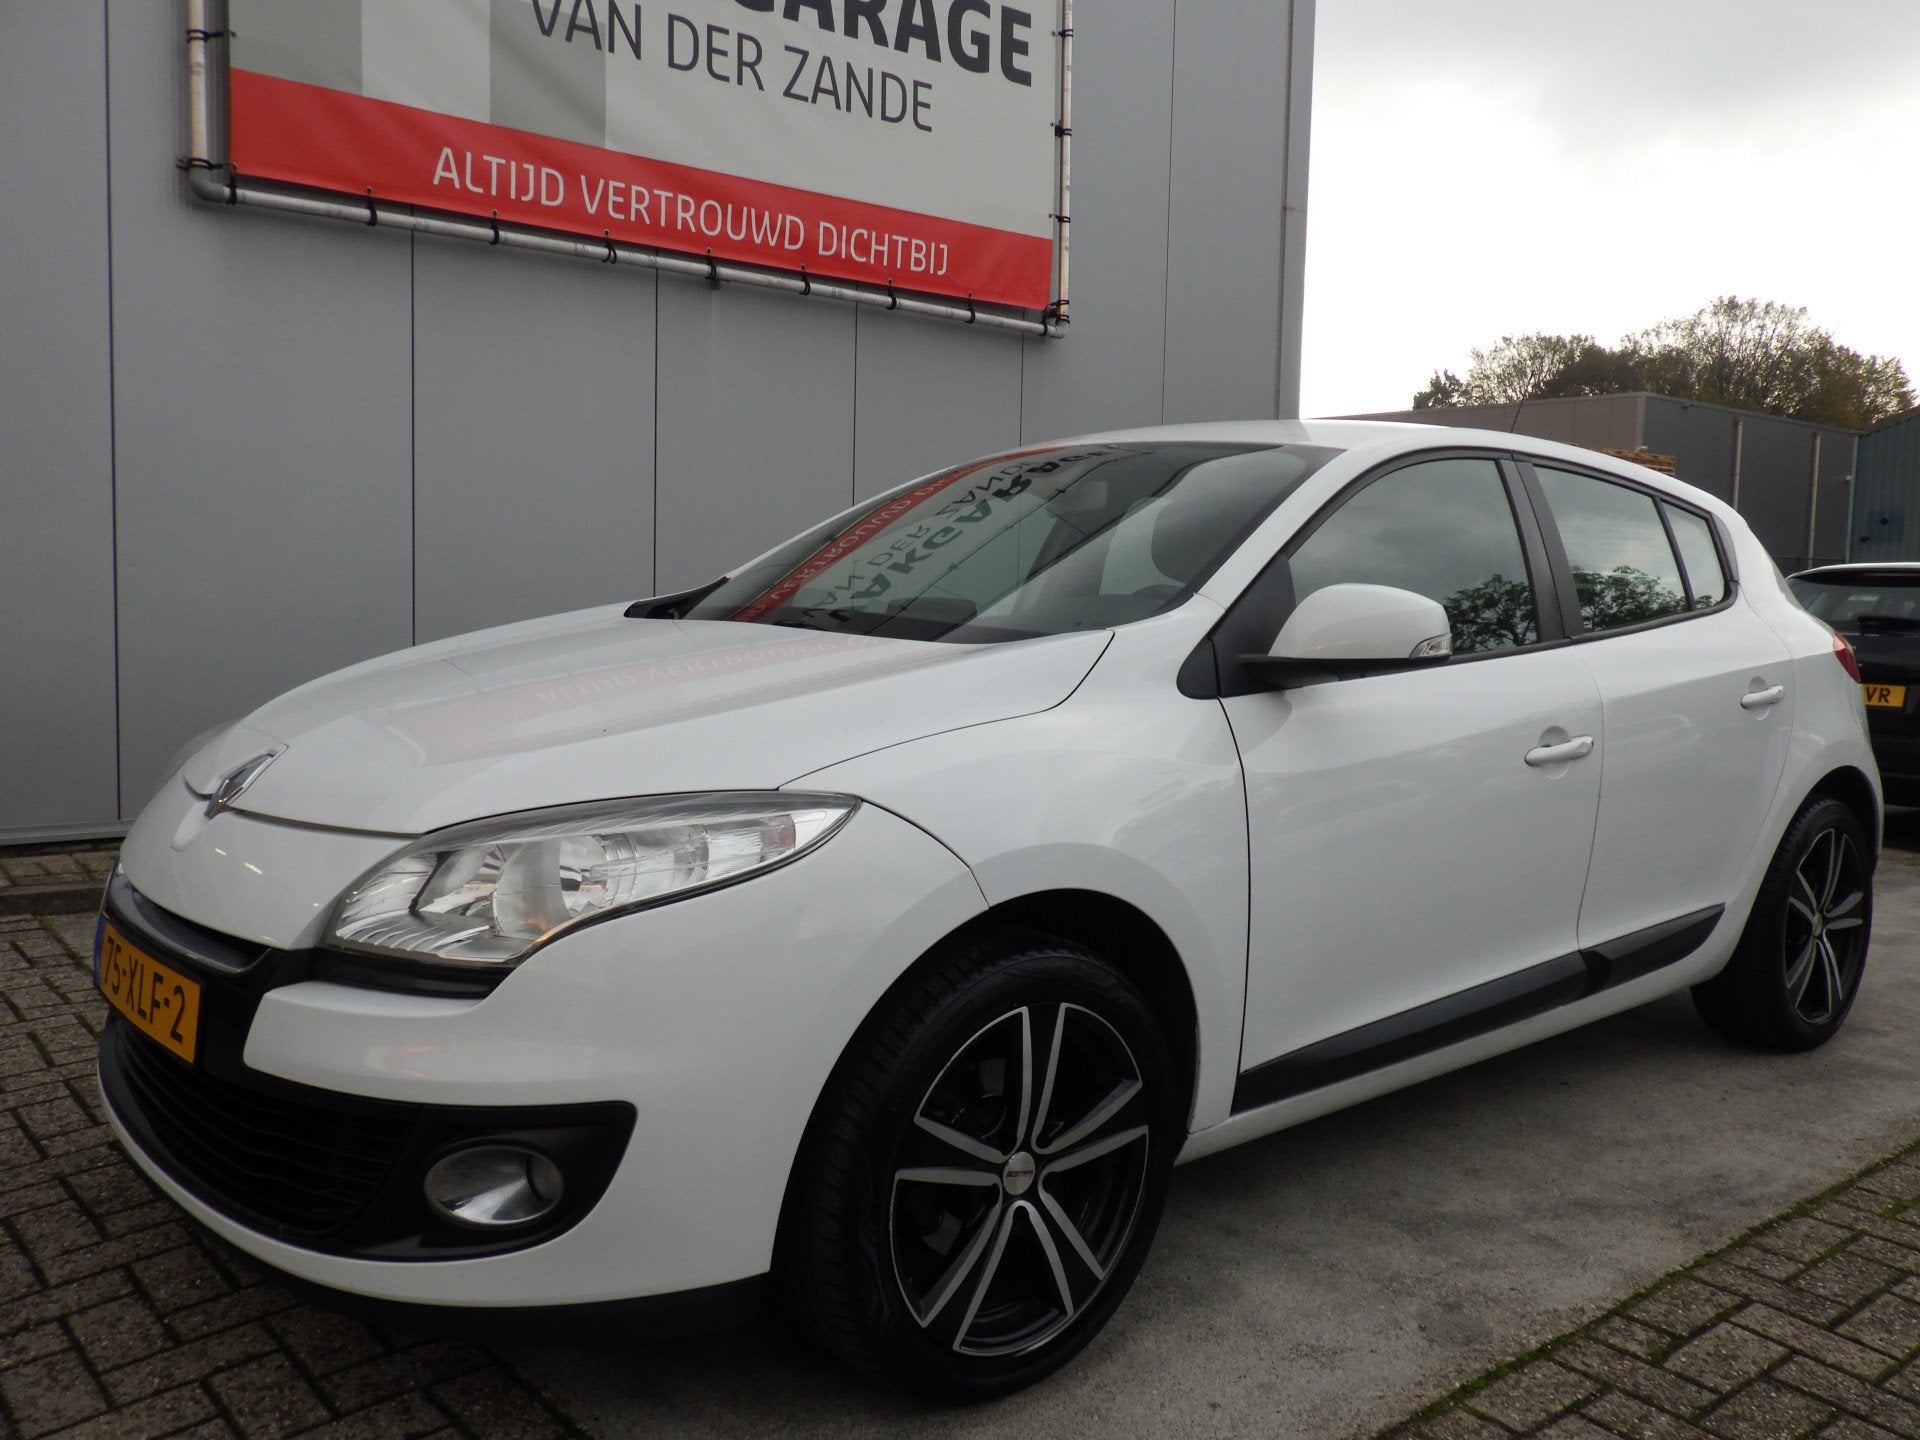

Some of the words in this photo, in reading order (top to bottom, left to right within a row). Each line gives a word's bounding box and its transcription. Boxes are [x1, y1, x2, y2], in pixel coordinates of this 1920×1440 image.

[531, 0, 642, 61] VAN
[667, 13, 765, 92] DER
[783, 45, 933, 133] ZANDE
[728, 0, 1032, 87] RAGE
[433, 147, 564, 207] ALTIJD
[580, 175, 805, 251] VERTROUWD
[818, 222, 948, 276] DICHTBIJ
[104, 935, 186, 1044] 75-XLF-2
